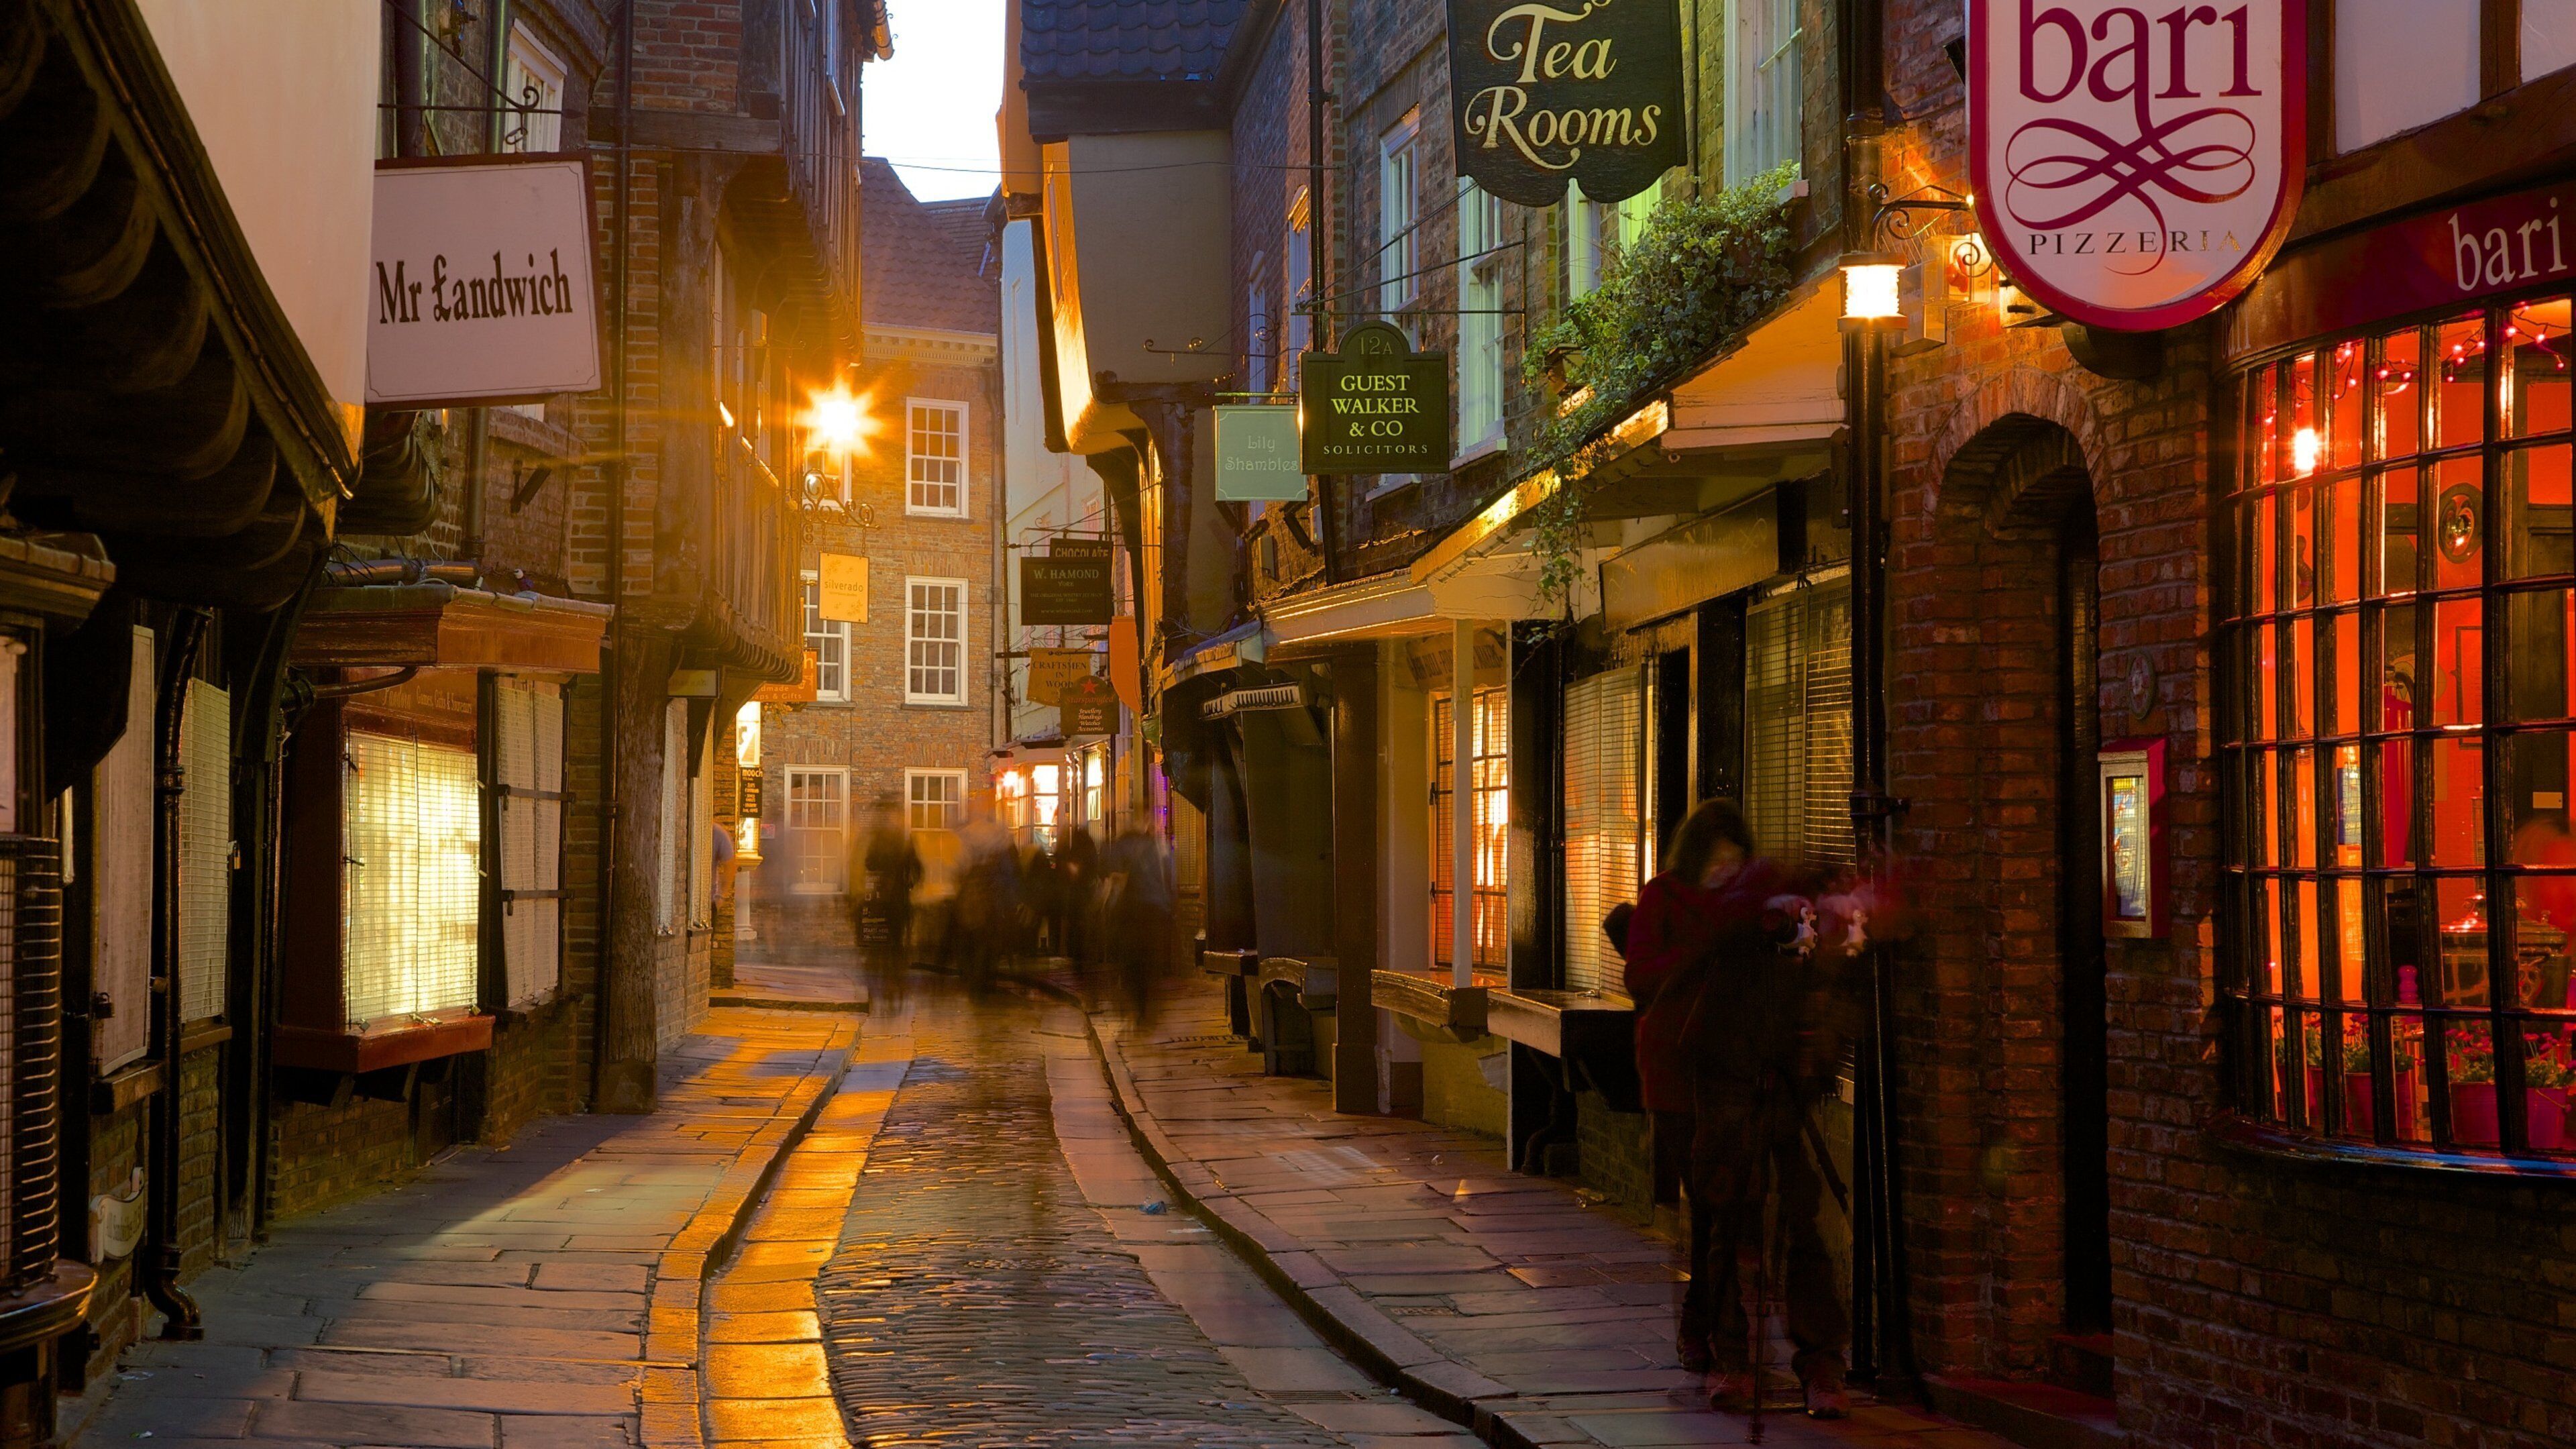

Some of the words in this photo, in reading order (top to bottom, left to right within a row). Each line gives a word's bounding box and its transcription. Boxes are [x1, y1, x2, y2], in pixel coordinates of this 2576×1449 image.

[1487, 3, 1617, 83] Tea
[2020, 0, 2262, 104] bari
[1464, 86, 1662, 169] Rooms
[2028, 229, 2243, 256] PIZZERIA
[2448, 197, 2568, 291] bari
[376, 260, 422, 324] Mr
[1359, 336, 1394, 355] 12A
[1340, 374, 1411, 392] GUEST
[1331, 397, 1421, 415] WALKER
[1349, 422, 1364, 437] &
[1371, 420, 1403, 437] CO
[1247, 435, 1276, 453] Lily
[1323, 444, 1428, 455] SOLICITORS
[1224, 456, 1299, 473] Shambles
[1050, 568, 1099, 580] HAMOND
[824, 579, 864, 592] silverado
[1032, 661, 1087, 669] CRAFTSMEN
[742, 768, 763, 777] mooch
